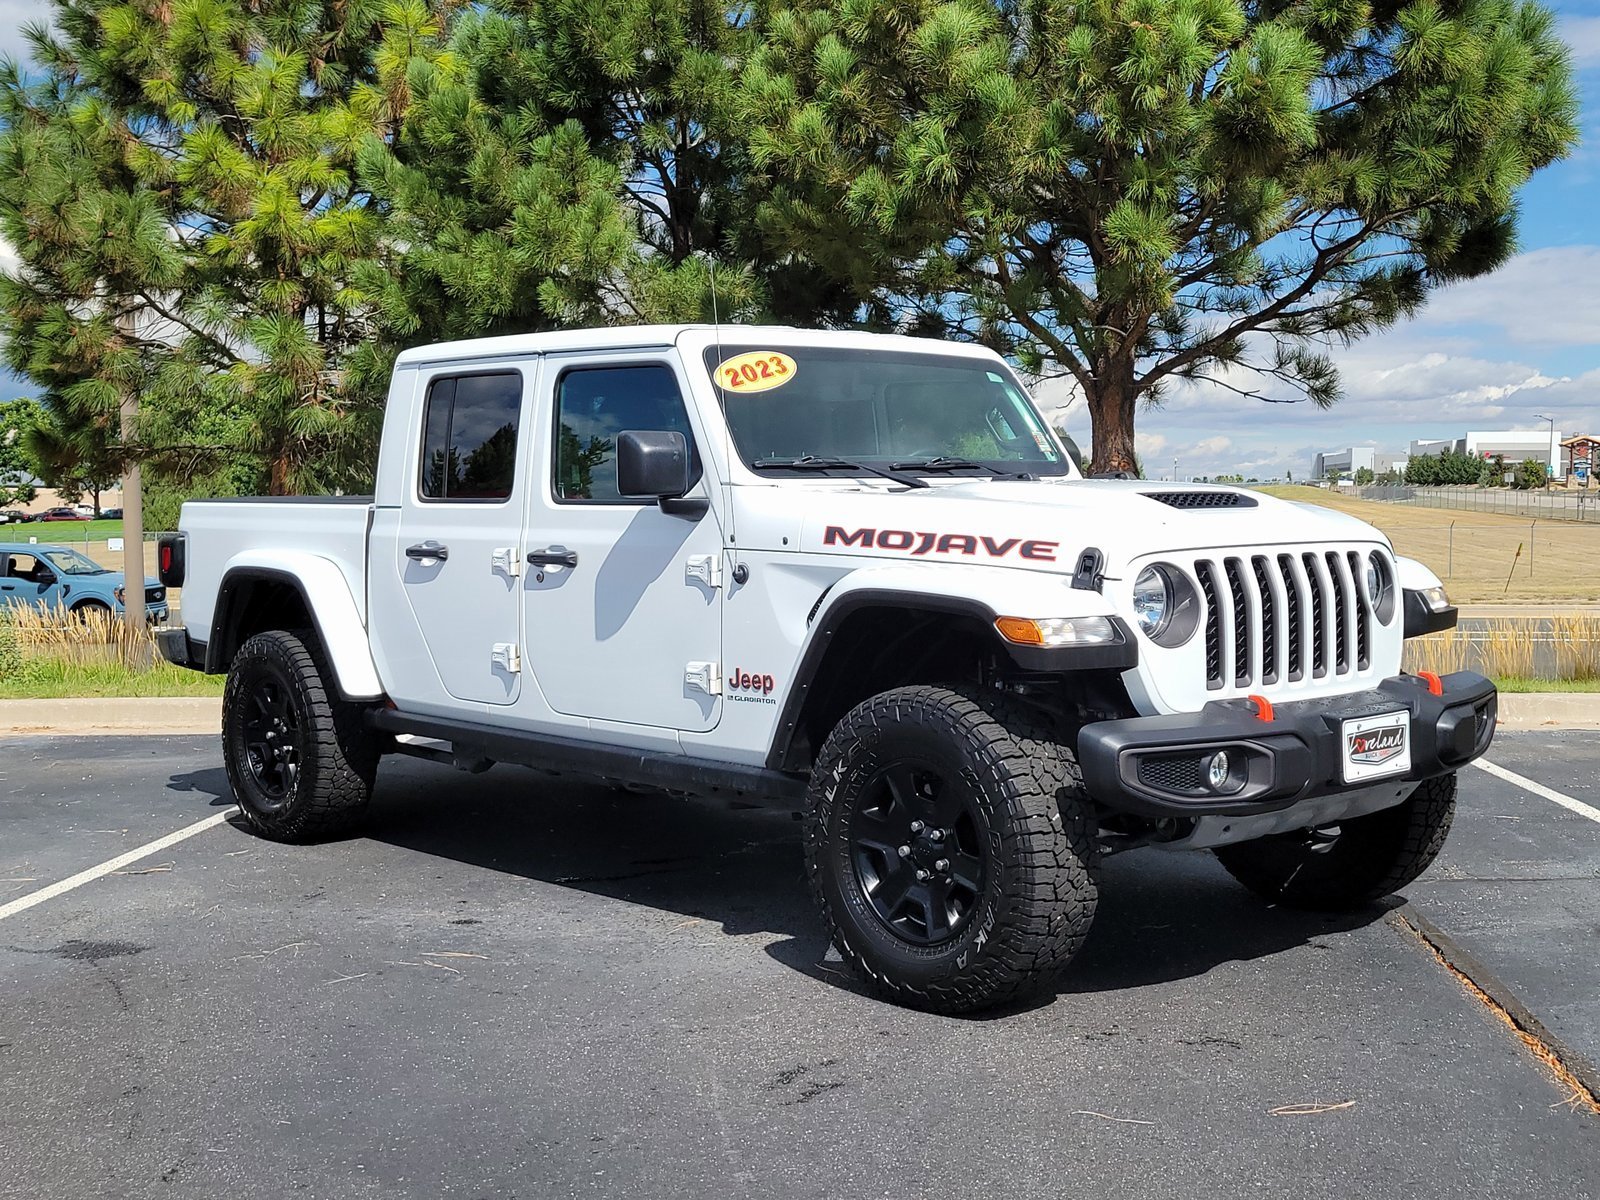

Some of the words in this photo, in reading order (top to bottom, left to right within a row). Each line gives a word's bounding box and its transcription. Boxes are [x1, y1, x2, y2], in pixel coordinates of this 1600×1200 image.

[725, 356, 788, 388] 2023
[823, 525, 1060, 562] MOJAVE
[729, 667, 774, 696] Jeep
[734, 695, 777, 705] GLADIATOR
